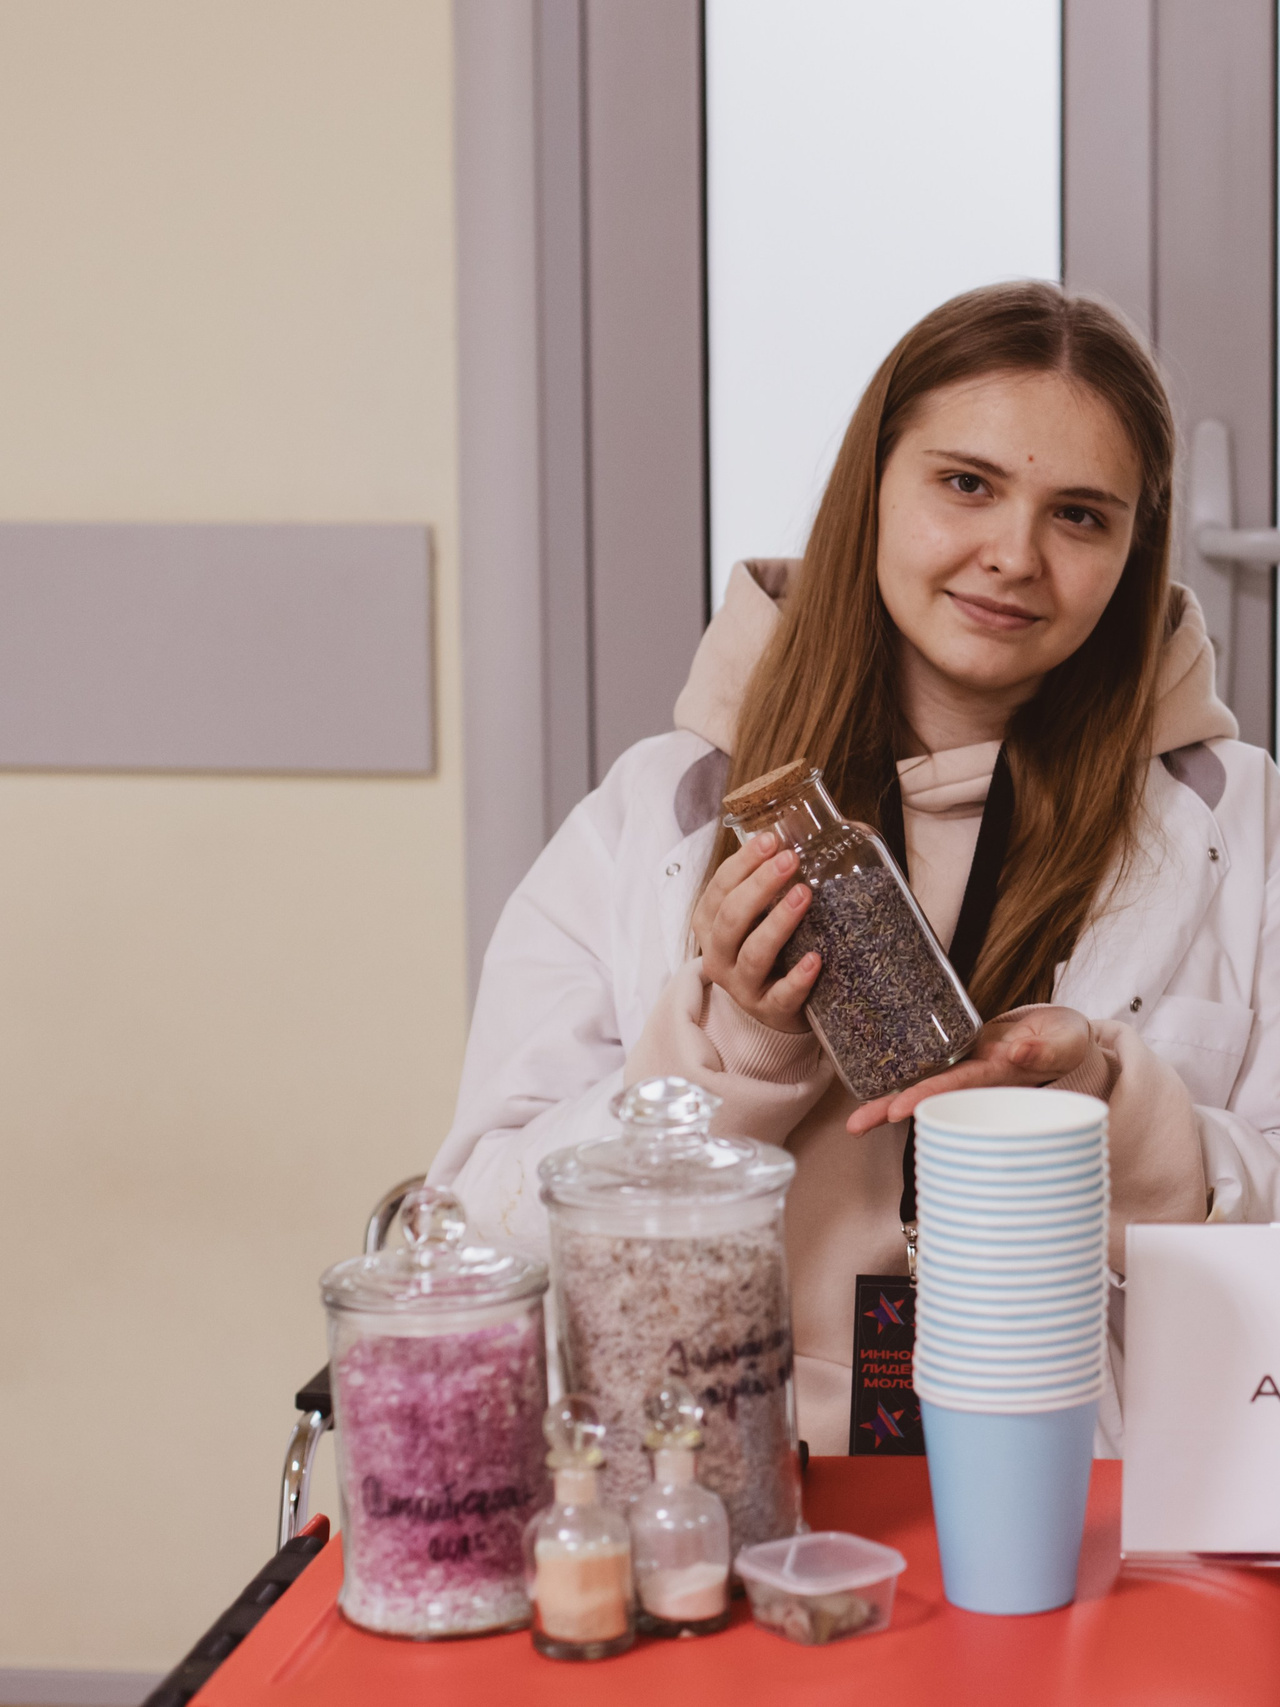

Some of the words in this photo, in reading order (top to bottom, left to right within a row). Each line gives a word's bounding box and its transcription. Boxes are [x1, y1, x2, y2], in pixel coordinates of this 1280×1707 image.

[860, 1348, 912, 1361] ИННО
[861, 1363, 912, 1376] ЛИДЕ
[863, 1377, 914, 1390] МОЛО
